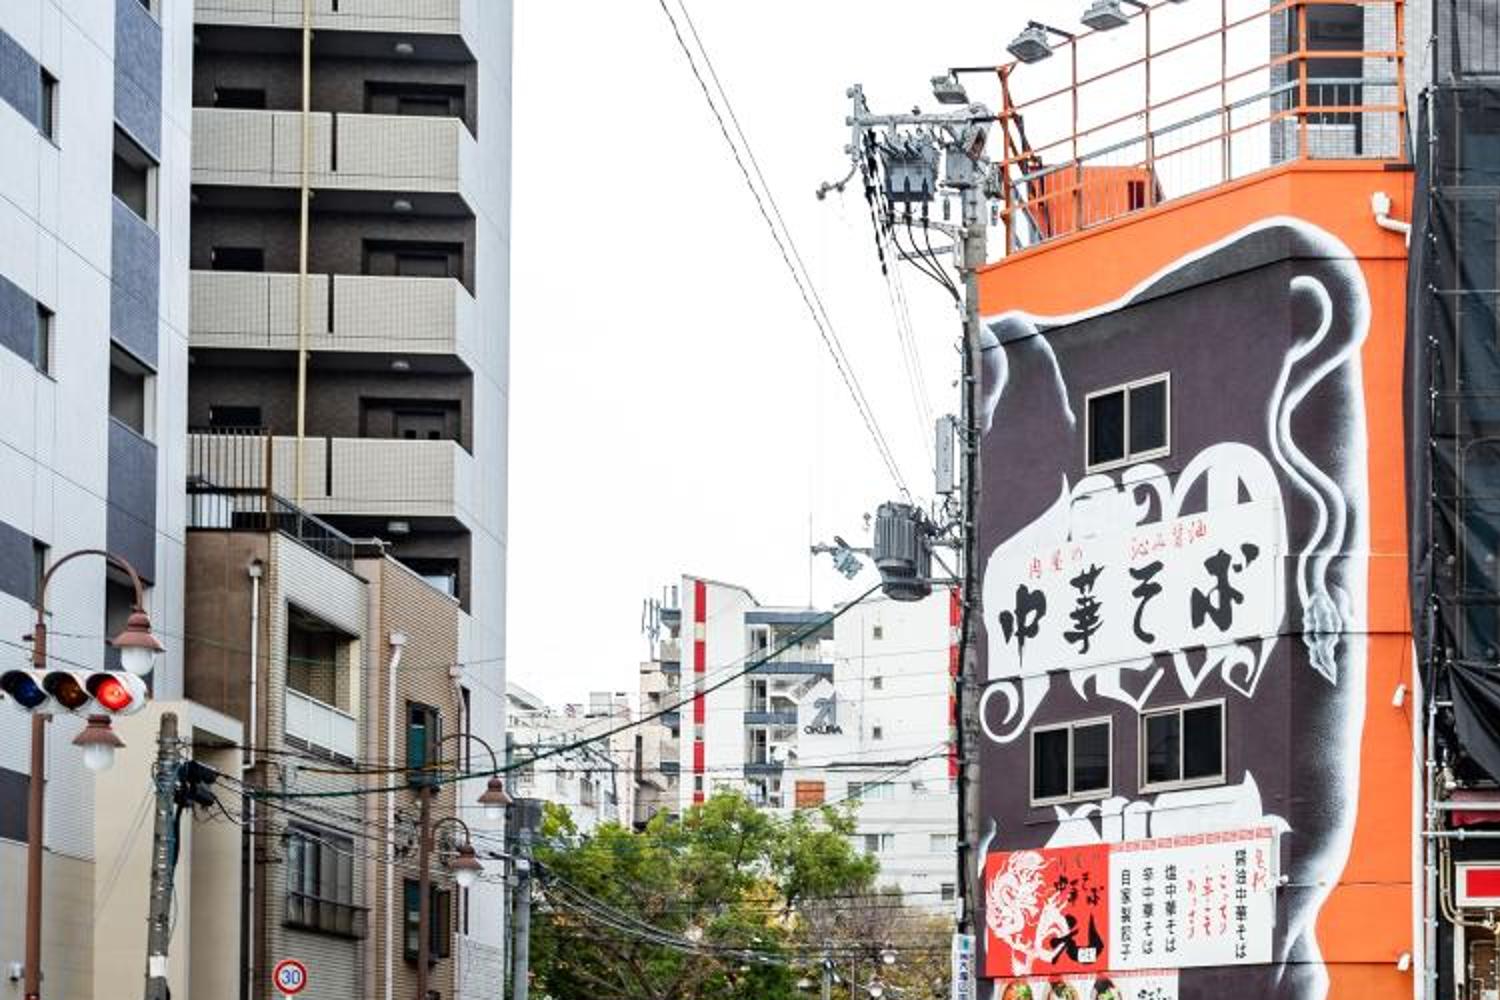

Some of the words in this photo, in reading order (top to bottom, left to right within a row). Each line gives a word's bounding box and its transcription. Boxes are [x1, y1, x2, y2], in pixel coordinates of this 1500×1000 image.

[1000, 543, 1260, 667] 中華そば
[282, 969, 301, 985] 30
